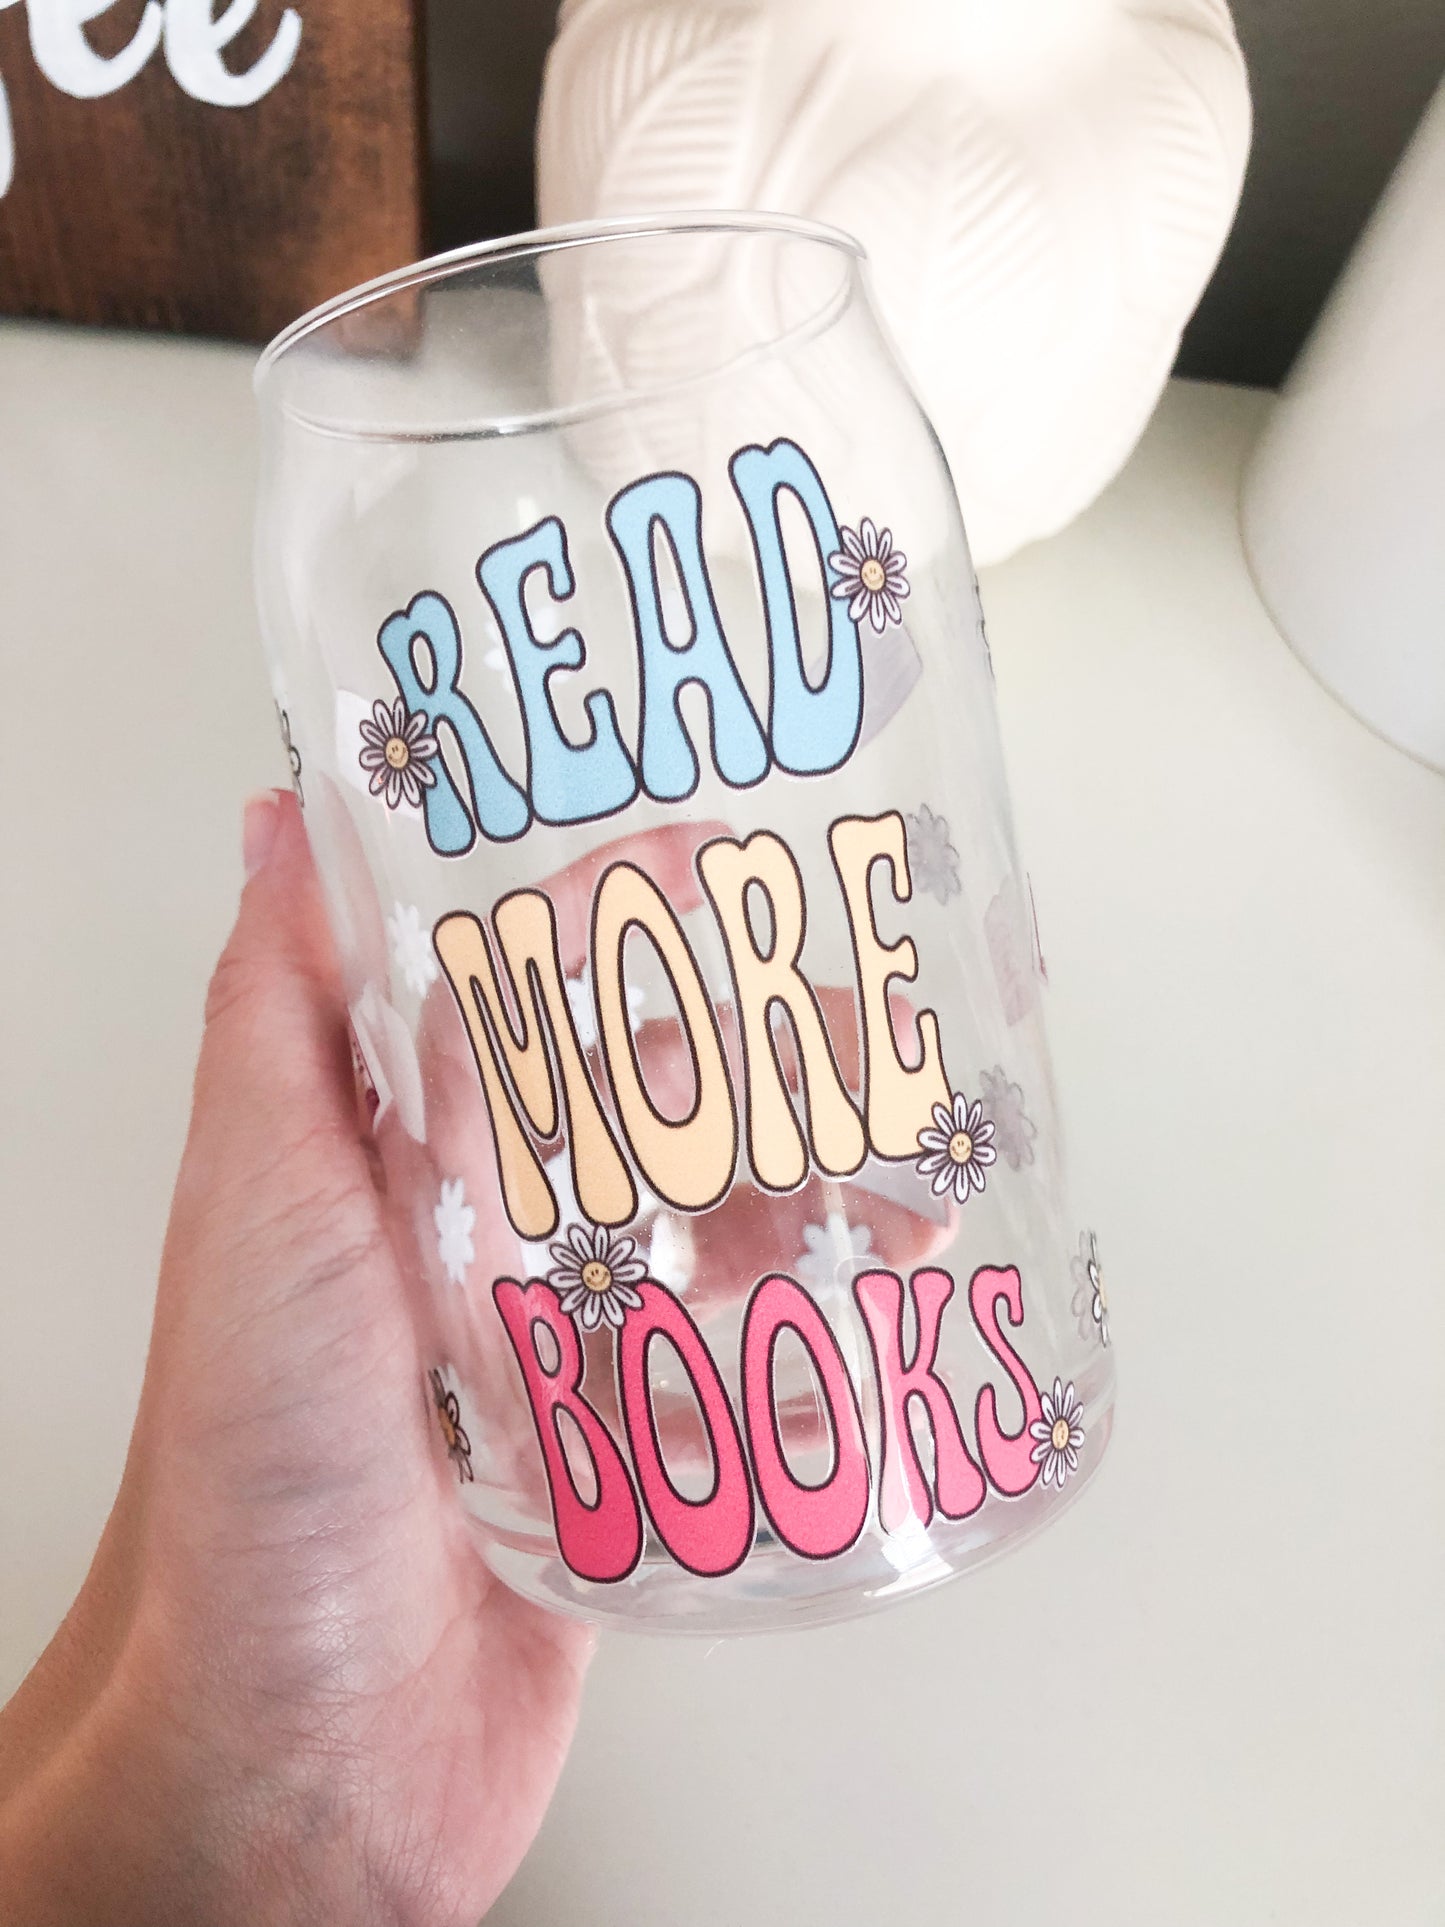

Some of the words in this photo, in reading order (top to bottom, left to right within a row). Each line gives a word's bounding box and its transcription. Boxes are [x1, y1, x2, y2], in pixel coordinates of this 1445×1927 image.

[377, 437, 864, 858] READ
[433, 809, 951, 1240] MORE
[492, 1264, 1041, 1583] BOOKS
